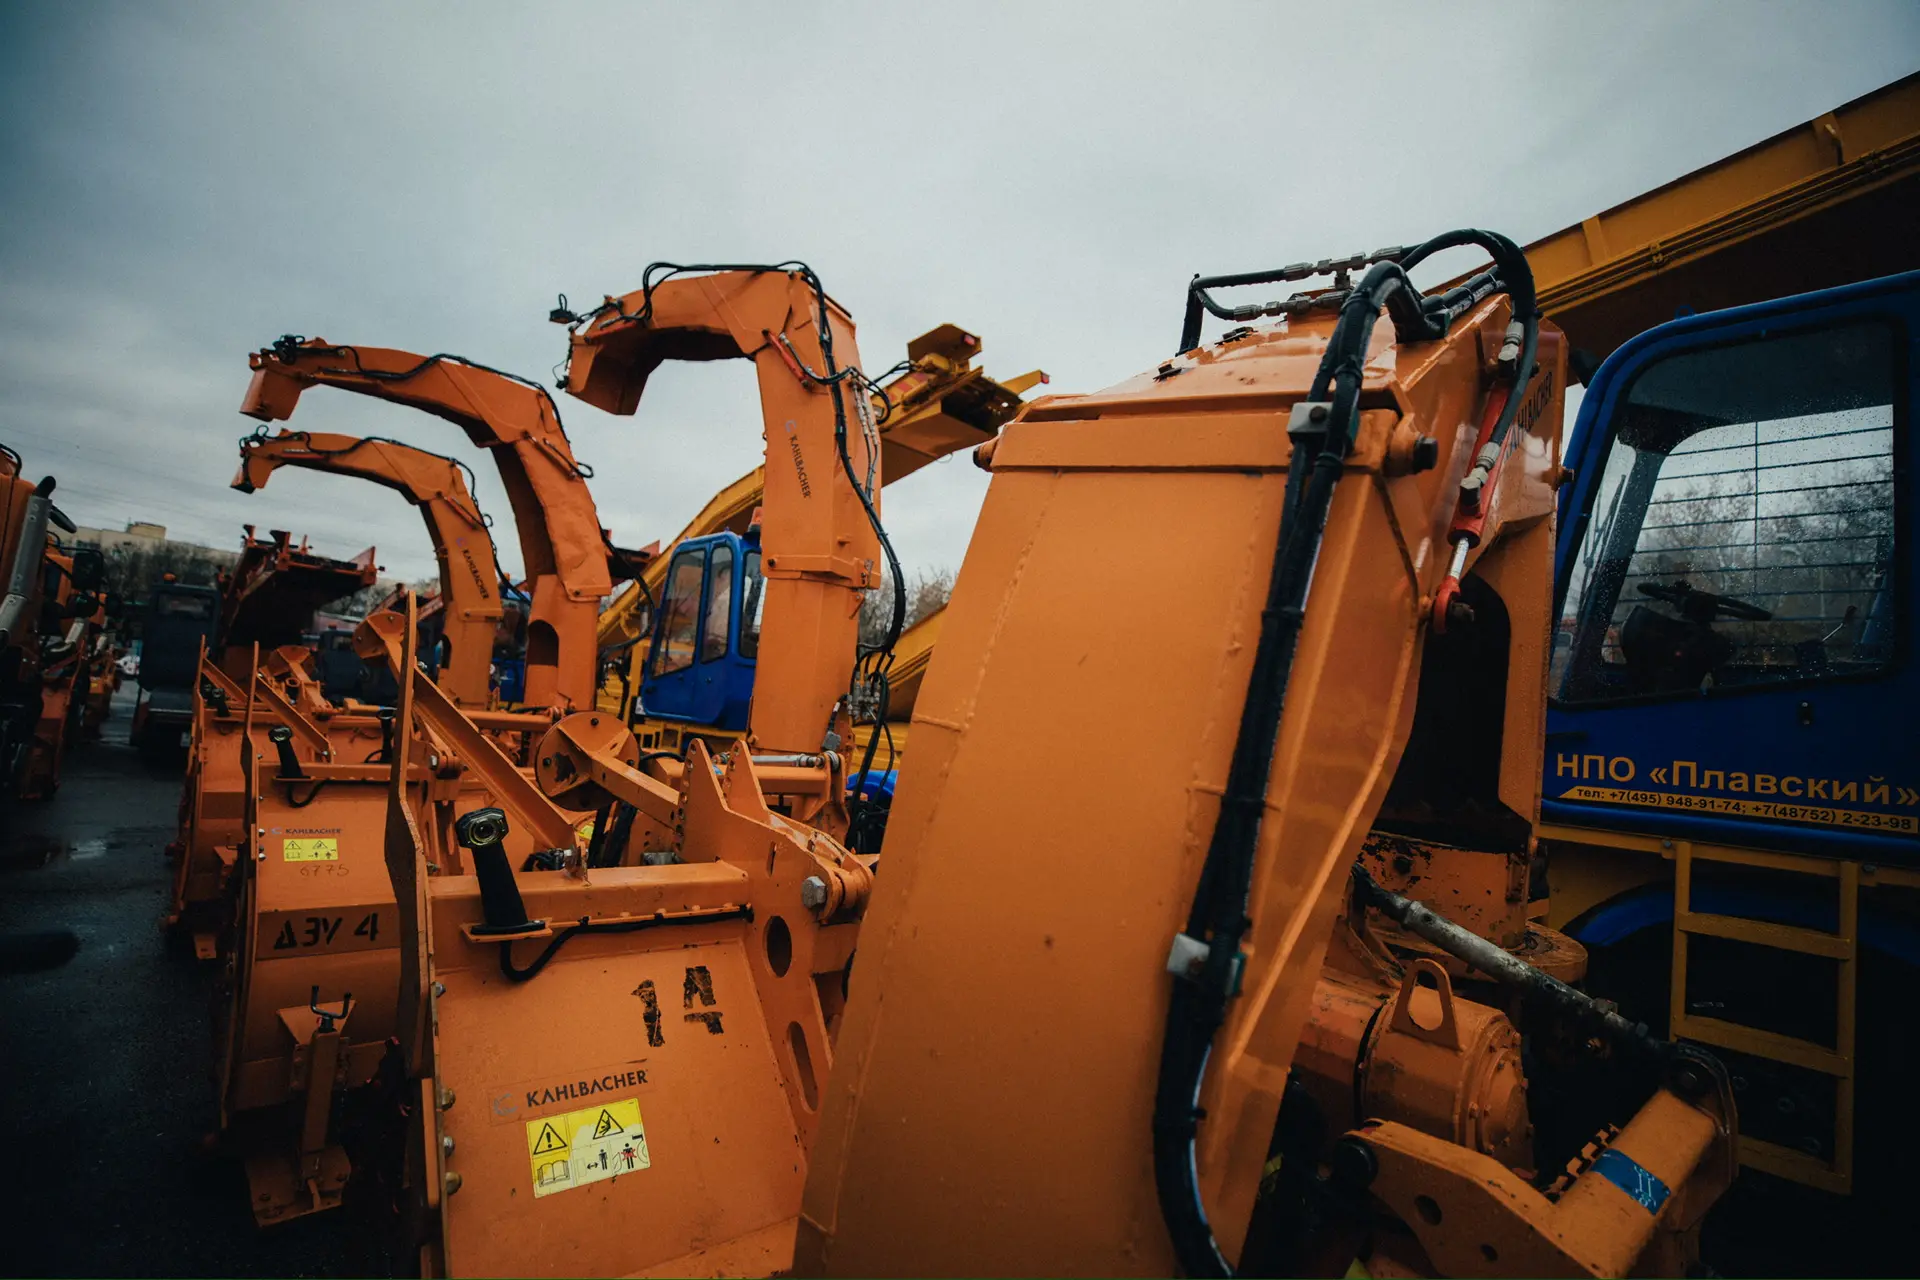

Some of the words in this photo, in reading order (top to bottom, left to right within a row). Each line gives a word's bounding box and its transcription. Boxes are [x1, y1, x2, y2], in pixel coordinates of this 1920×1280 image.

[1505, 372, 1553, 458] AHLBACHER
[789, 434, 812, 499] KAHLBACHER
[1556, 752, 1636, 783] НПО
[1649, 759, 1920, 806] «Плавский»
[1577, 788, 1605, 799] тел:
[1610, 790, 1662, 805] +7(495)
[1666, 795, 1747, 814] 948-91-74;
[1752, 803, 1837, 823] +7(48752)
[1842, 812, 1912, 830] 2-23-98
[285, 827, 342, 835] KAHLBACHER
[354, 912, 378, 941] 4
[526, 1069, 649, 1108] KAHLBACHER
